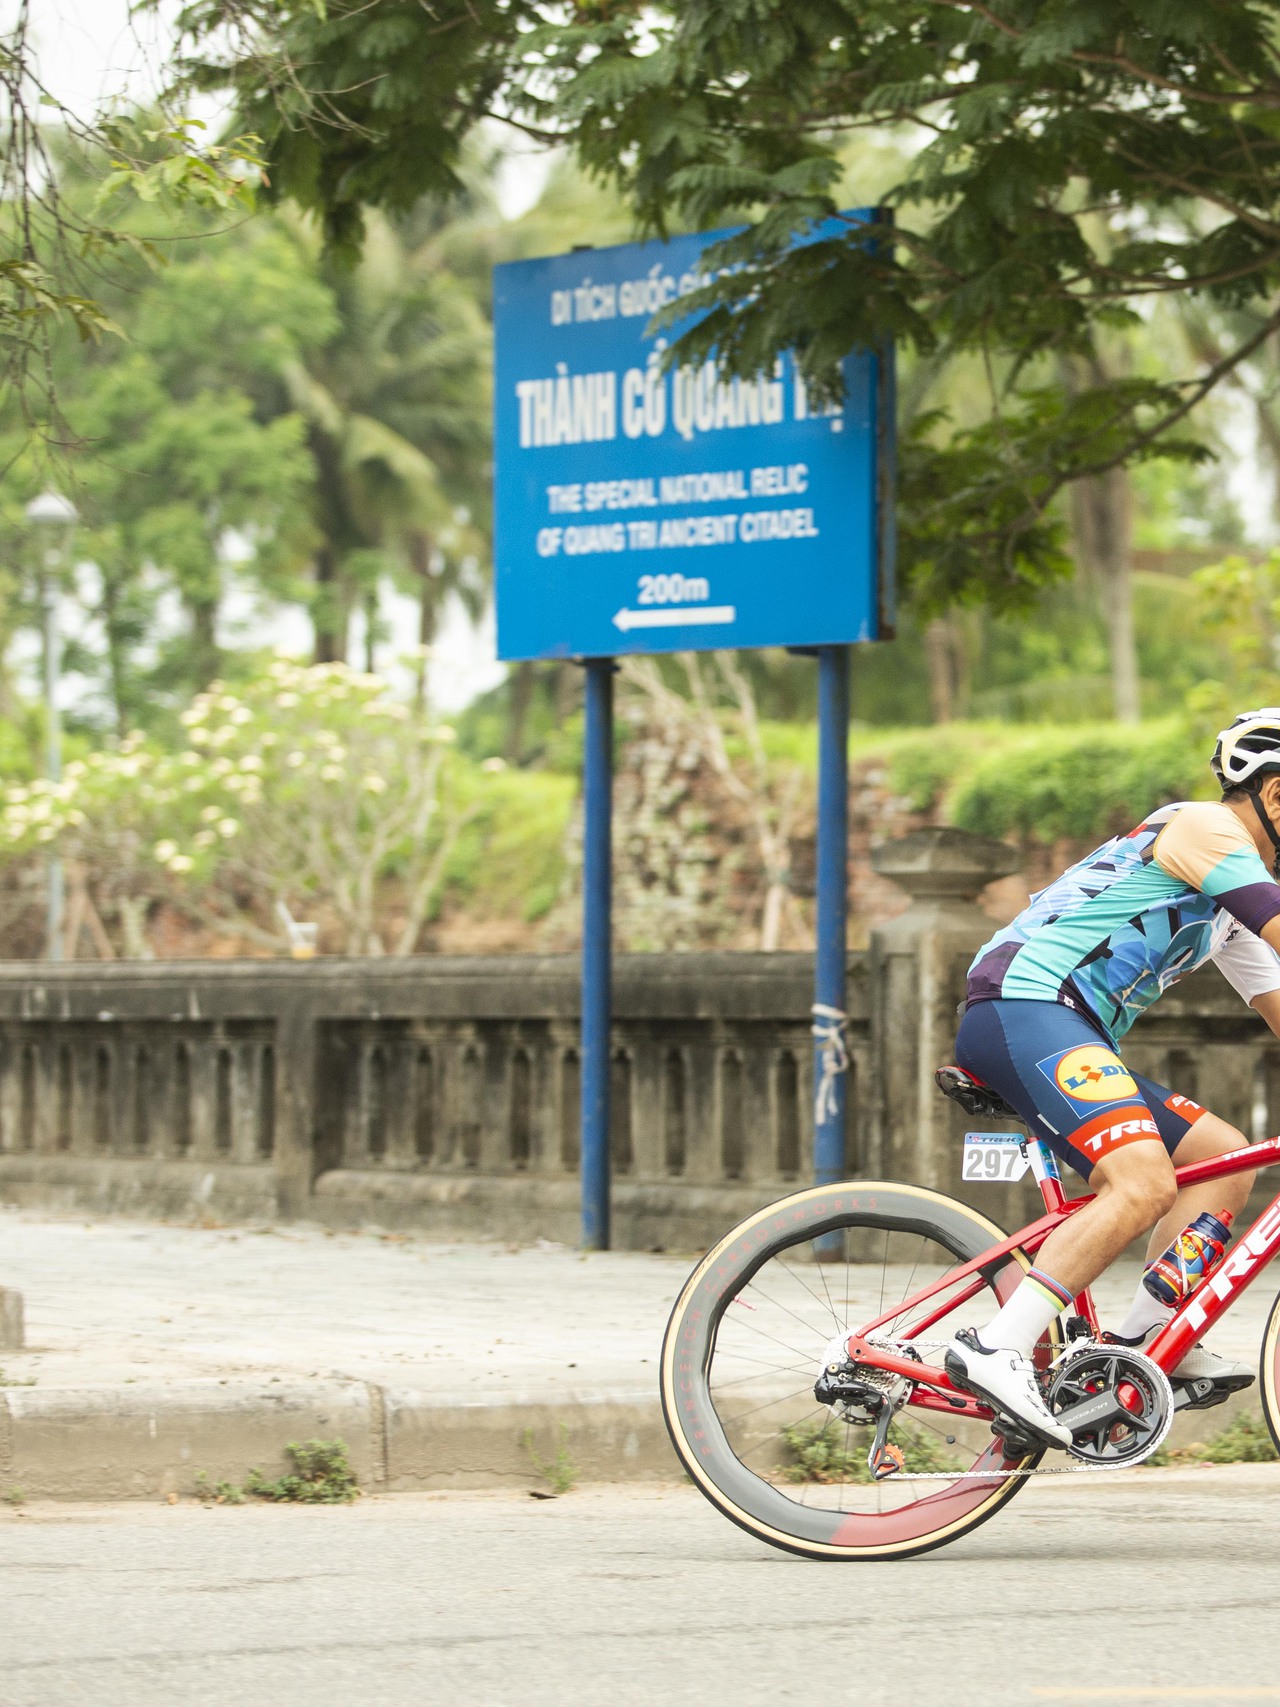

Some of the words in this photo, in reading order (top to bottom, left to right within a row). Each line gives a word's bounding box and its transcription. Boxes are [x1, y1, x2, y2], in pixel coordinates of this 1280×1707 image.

[574, 277, 616, 322] TÍCH
[515, 362, 616, 448] THÀNH
[622, 338, 667, 439] CỔ
[546, 483, 582, 514] THE
[584, 478, 658, 512] SPECIAL
[660, 470, 748, 504] NATIONAL
[750, 463, 809, 497] RELIC
[536, 527, 563, 557] OF
[563, 522, 626, 555] QUANG
[627, 520, 658, 550] TRI
[658, 514, 738, 548] ANCIENT
[739, 507, 820, 543] CITADEL
[637, 573, 709, 604] 200m
[966, 1149, 1019, 1178] 297
[705, 1198, 877, 1293] CARBONWORKS
